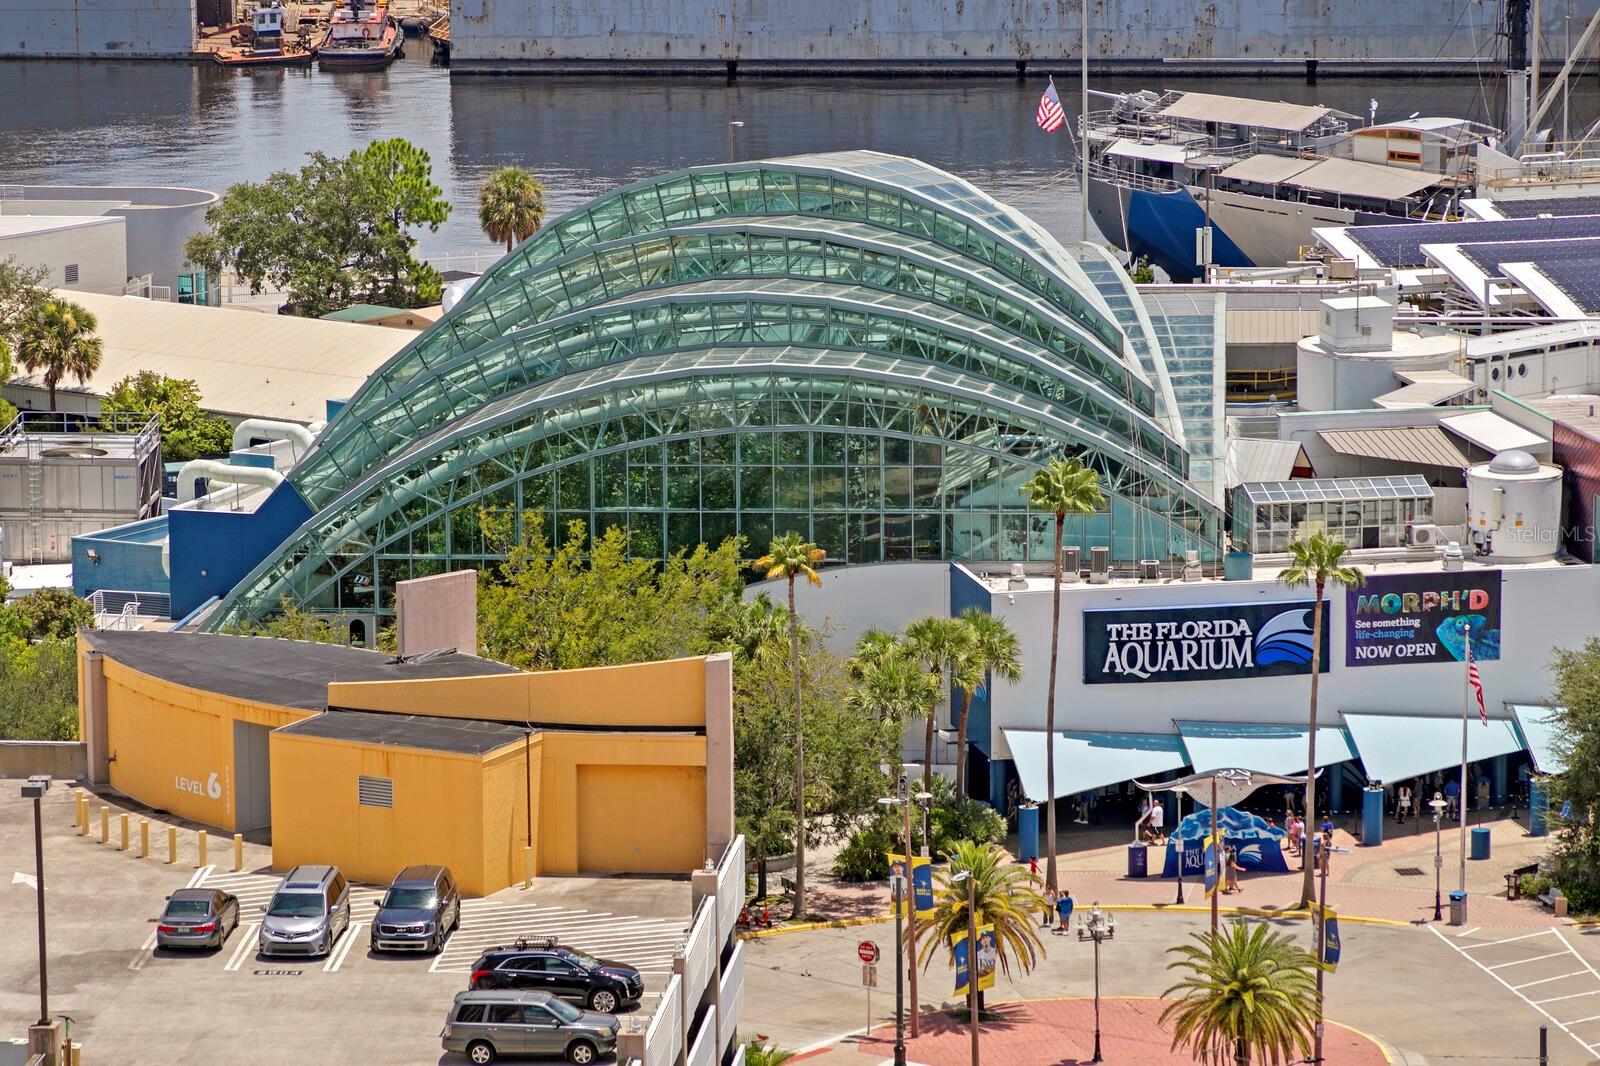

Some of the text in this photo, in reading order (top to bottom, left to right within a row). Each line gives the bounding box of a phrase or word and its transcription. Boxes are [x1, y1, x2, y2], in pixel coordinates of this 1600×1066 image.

[1356, 589, 1489, 615] MORPH'D
[1106, 618, 1253, 641] THE FLORIDA
[1355, 617, 1421, 629] See something
[1355, 628, 1415, 639] life-changing
[1102, 637, 1255, 679] AQUARIUM
[1355, 643, 1438, 659] NOW OPEN
[175, 776, 206, 796] LEVEL
[207, 771, 222, 800] 6
